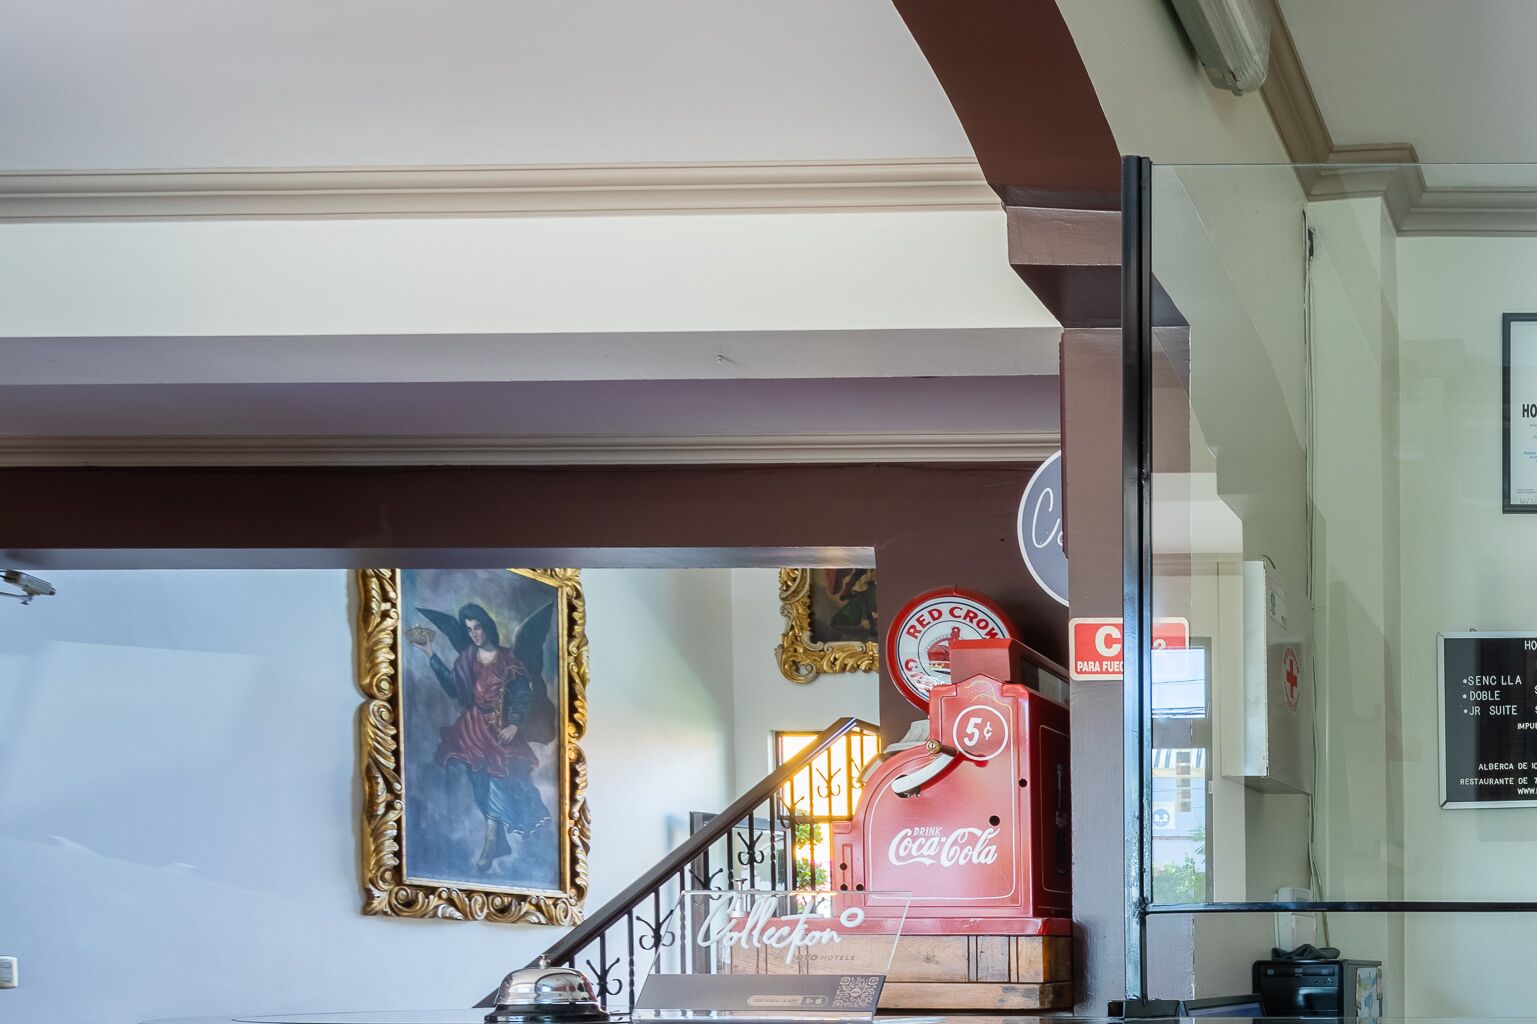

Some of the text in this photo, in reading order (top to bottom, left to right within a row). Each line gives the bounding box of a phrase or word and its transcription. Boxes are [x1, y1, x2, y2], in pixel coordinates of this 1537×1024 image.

[905, 608, 943, 639] RED
[1077, 661, 1101, 672] PARA
[1469, 690, 1501, 701] DOBLE
[1469, 705, 1518, 716] JR SUITE
[1478, 762, 1514, 771] ALBERCA
[1517, 762, 1528, 770] DE
[1460, 777, 1515, 786] RESTAURANTE
[1518, 776, 1528, 785] DE
[913, 826, 943, 837] DRINK
[888, 827, 1001, 868] Coca-Cola
[820, 953, 857, 962] HOTELS
